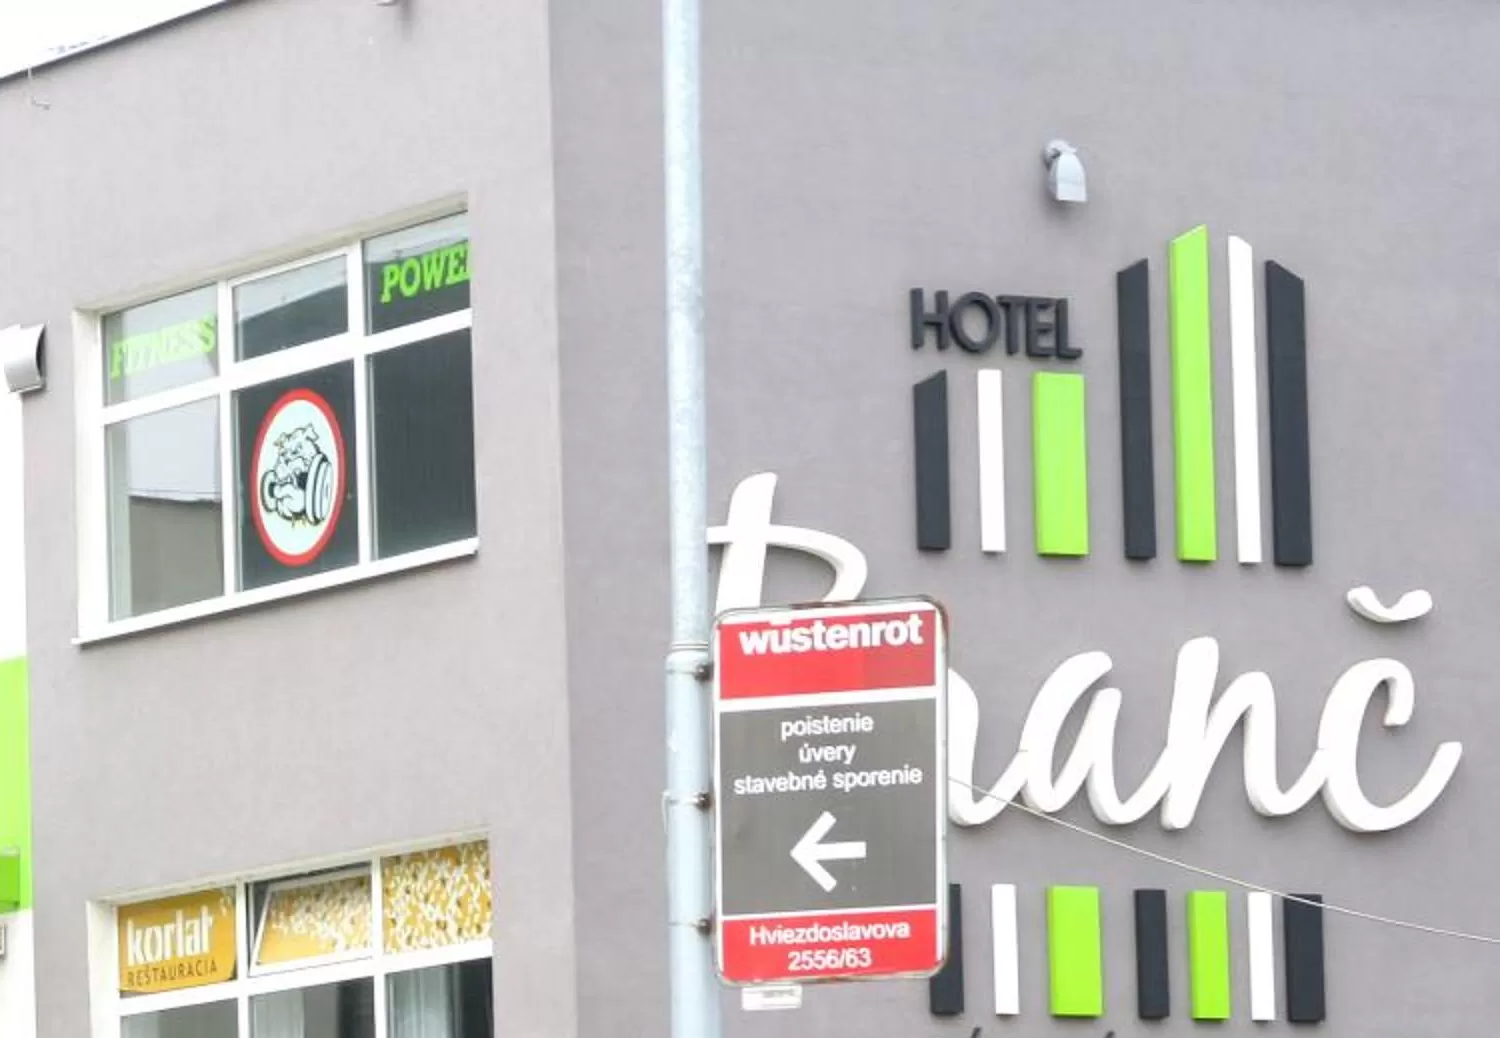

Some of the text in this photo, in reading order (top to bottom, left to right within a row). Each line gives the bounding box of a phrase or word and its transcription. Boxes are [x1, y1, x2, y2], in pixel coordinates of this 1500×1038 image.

[380, 241, 471, 304] POWE
[909, 287, 1083, 360] HOTEL
[109, 315, 215, 380] FITNESS
[780, 711, 875, 742] poistenie
[797, 742, 857, 765] úvery
[733, 763, 923, 796] stavebné sporenie
[749, 921, 911, 946] Hviezdoslavova
[787, 947, 872, 972] 2556/63
